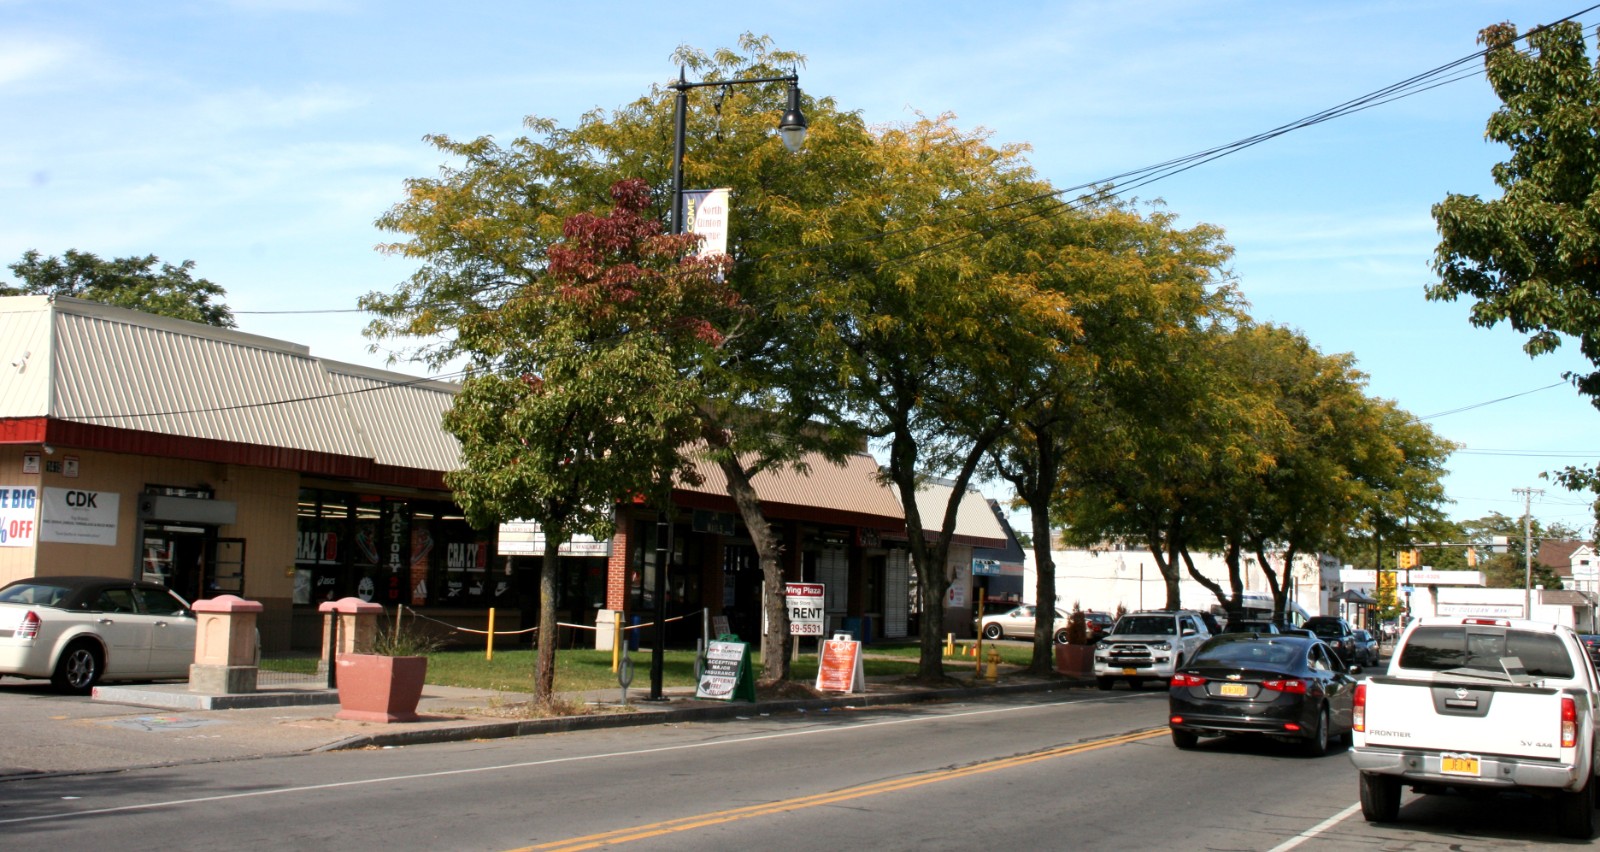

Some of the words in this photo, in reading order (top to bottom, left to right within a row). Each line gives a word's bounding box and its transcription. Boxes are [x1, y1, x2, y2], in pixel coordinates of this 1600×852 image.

[687, 198, 695, 233] COME
[703, 205, 722, 215] North
[697, 218, 722, 228] Clinton
[11, 489, 36, 508] BIG
[65, 490, 98, 508] CDK
[9, 519, 33, 538] OFF
[389, 503, 401, 572] FACTORY
[803, 586, 821, 594] Plaza
[793, 607, 822, 618] RENT
[830, 641, 851, 651] CDK
[1369, 729, 1411, 738] FRONTIER
